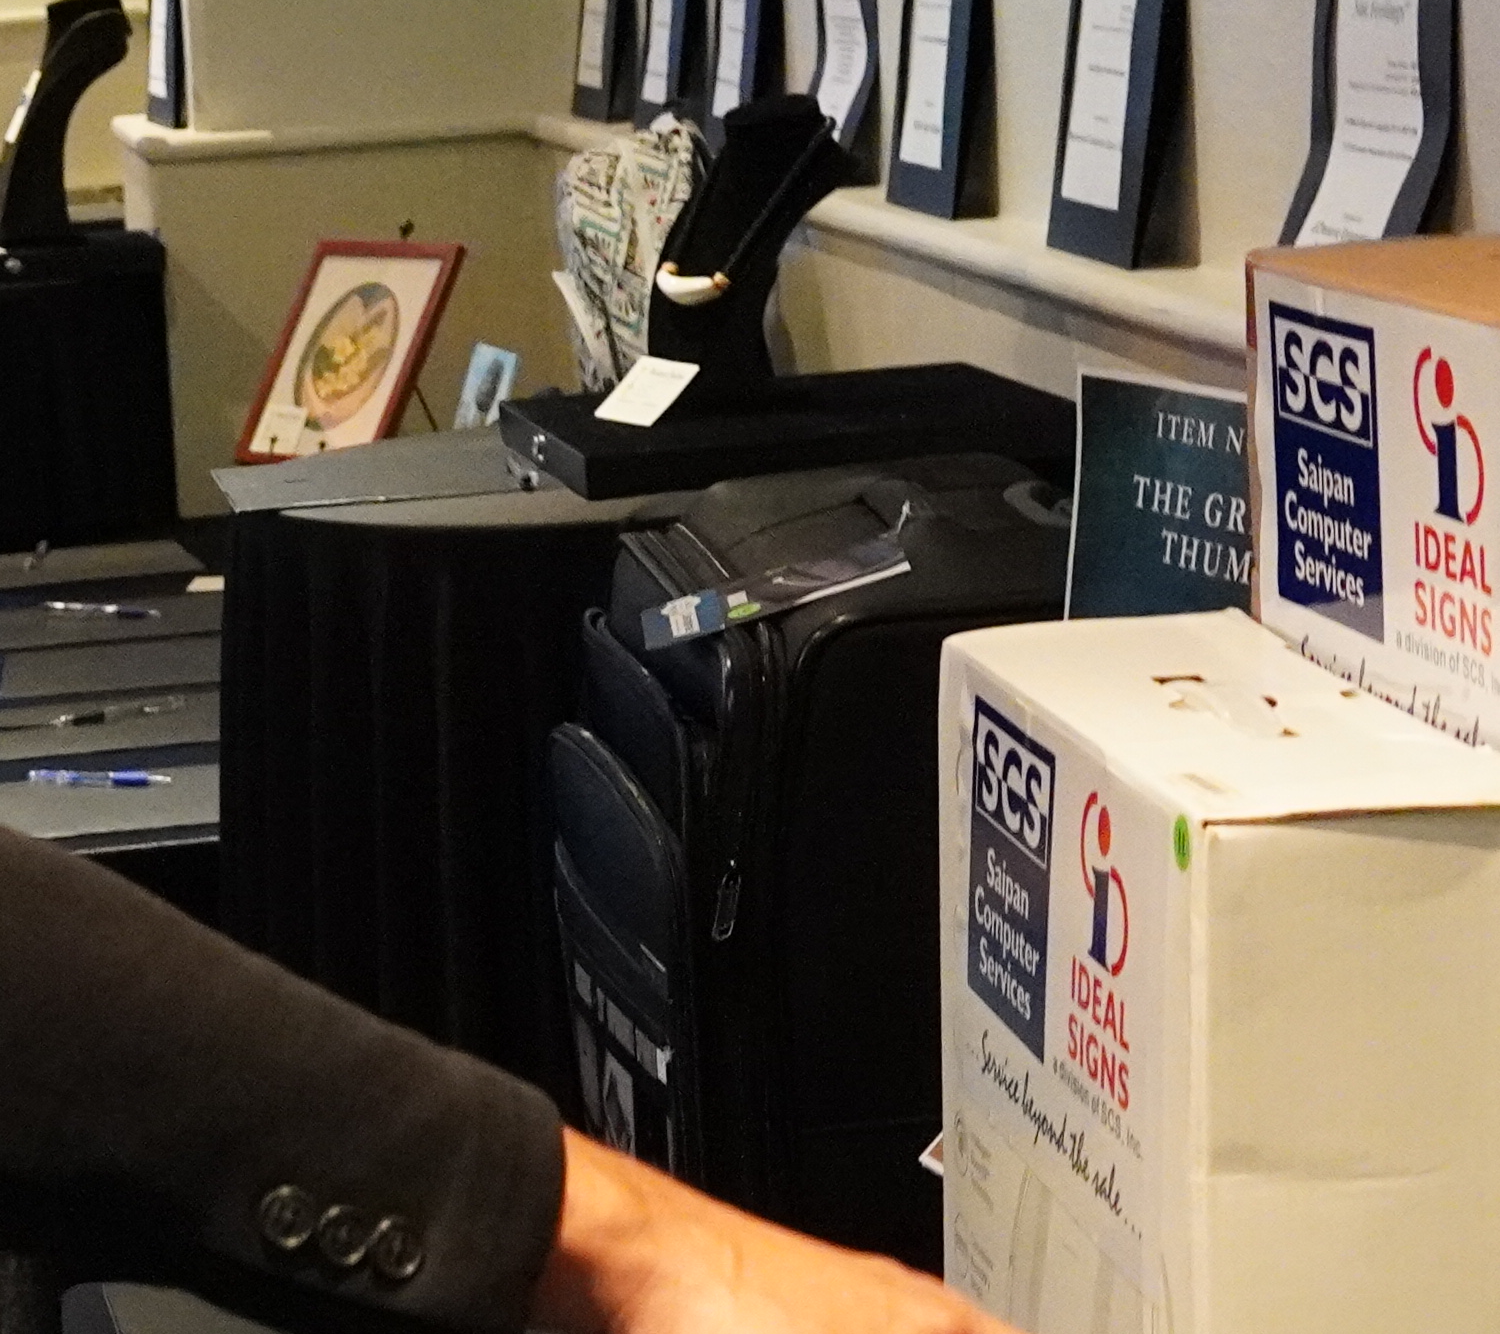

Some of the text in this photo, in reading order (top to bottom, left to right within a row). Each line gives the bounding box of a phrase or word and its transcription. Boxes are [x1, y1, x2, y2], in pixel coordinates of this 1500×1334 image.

[1283, 329, 1364, 435] SCS
[1155, 411, 1216, 450] ITEM
[1133, 473, 1193, 521] THE
[1296, 447, 1356, 509] Saipan
[1284, 490, 1373, 561] Computer
[1414, 520, 1492, 597] IDEAL
[1294, 539, 1365, 609] Services
[1404, 632, 1447, 667] division
[1449, 653, 1461, 675] of
[1414, 578, 1493, 658] SIGNS
[981, 728, 1042, 850] SCS
[986, 846, 1029, 921] Saipan
[974, 883, 1041, 977] Computer
[979, 936, 1032, 1021] Services
[1071, 954, 1130, 1054] IDEAL
[1068, 1012, 1130, 1111] SIGNS
[1020, 1070, 1068, 1155] beyond
[1069, 1130, 1090, 1183] the
